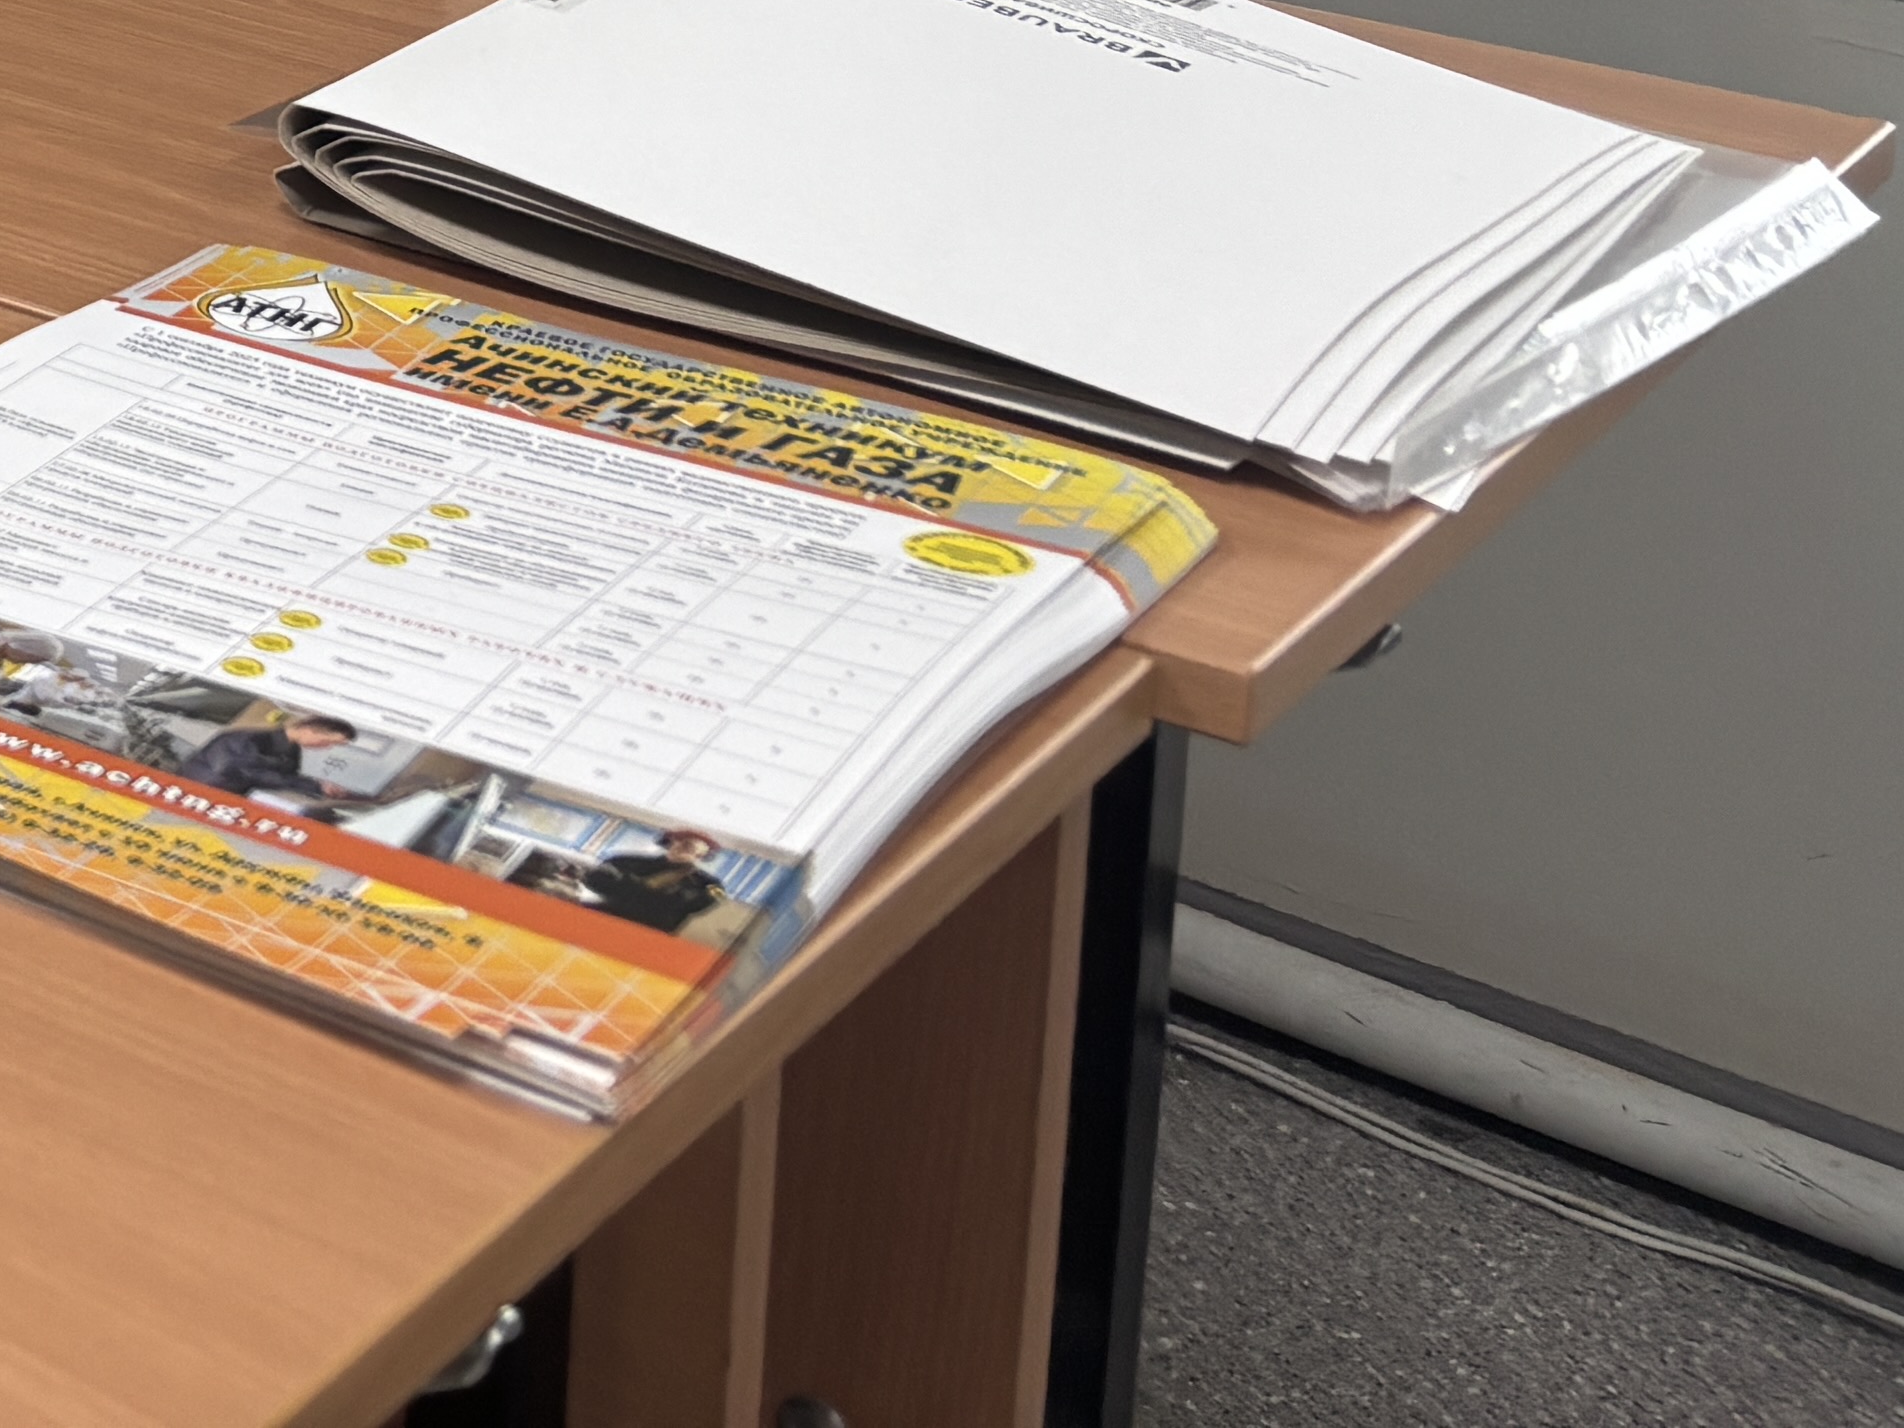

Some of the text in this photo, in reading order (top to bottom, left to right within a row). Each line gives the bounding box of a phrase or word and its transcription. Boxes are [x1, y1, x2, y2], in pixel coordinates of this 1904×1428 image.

[212, 294, 326, 334] АТНГ
[489, 319, 595, 351] КРАЕВОЕ
[402, 362, 554, 412] имени
[448, 332, 702, 406] Ачинский
[422, 346, 680, 424] НЕФТИ
[754, 431, 968, 497] ГАЗА
